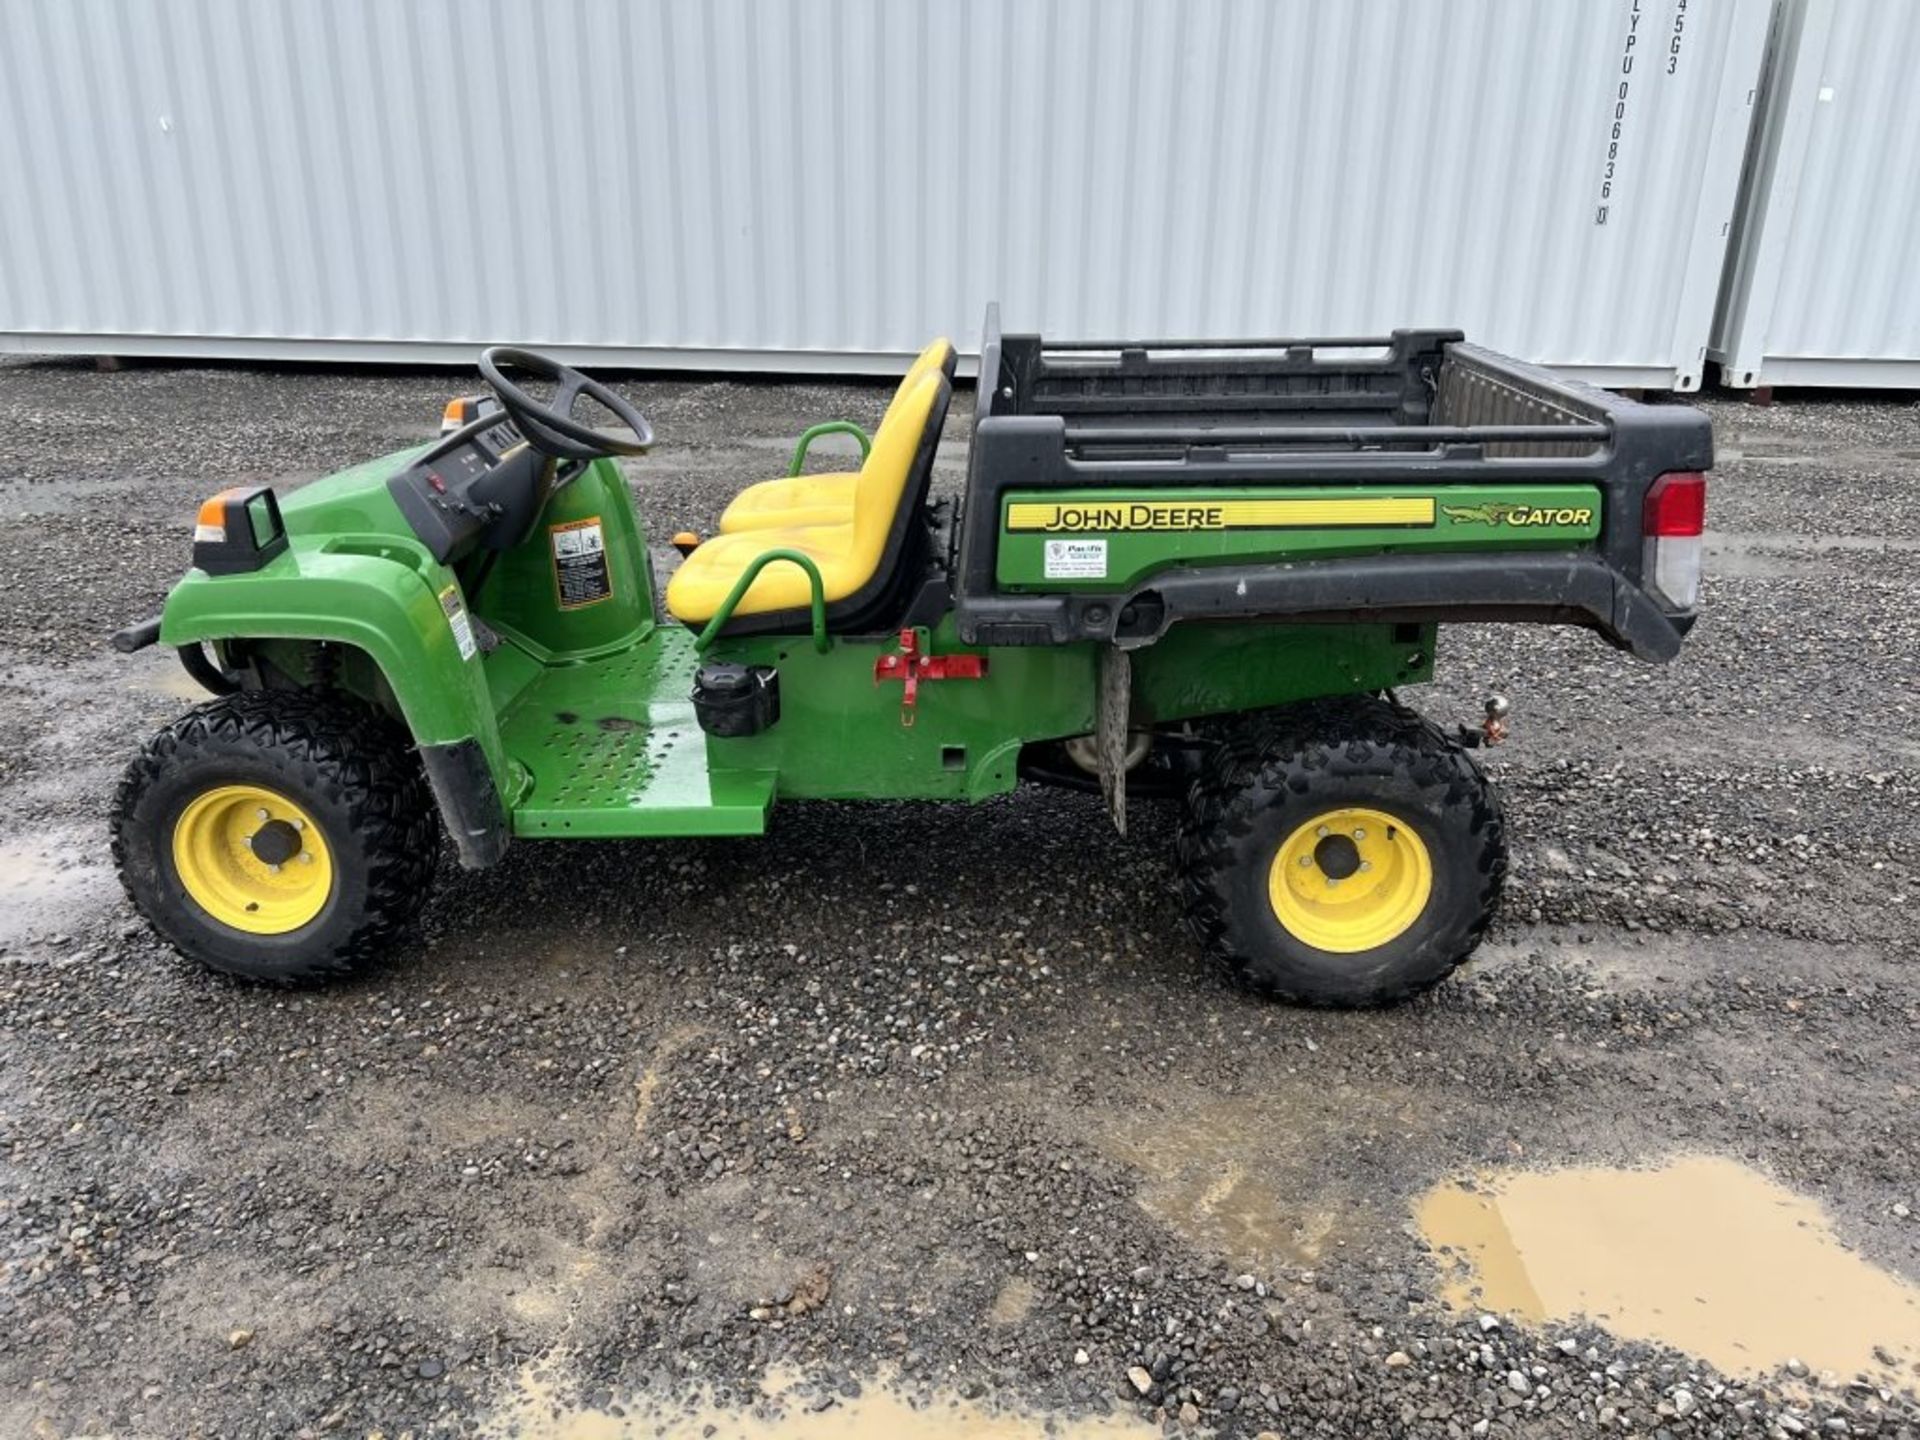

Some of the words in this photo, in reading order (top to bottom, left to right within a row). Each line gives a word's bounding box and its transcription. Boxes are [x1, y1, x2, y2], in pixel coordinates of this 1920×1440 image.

[1623, 0, 1641, 74] LYPU
[1601, 81, 1629, 199] 006836
[1595, 205, 1610, 225] 0
[1046, 506, 1122, 527] JOHN
[1130, 505, 1223, 527] DEERE
[1507, 506, 1591, 526] GATOR
